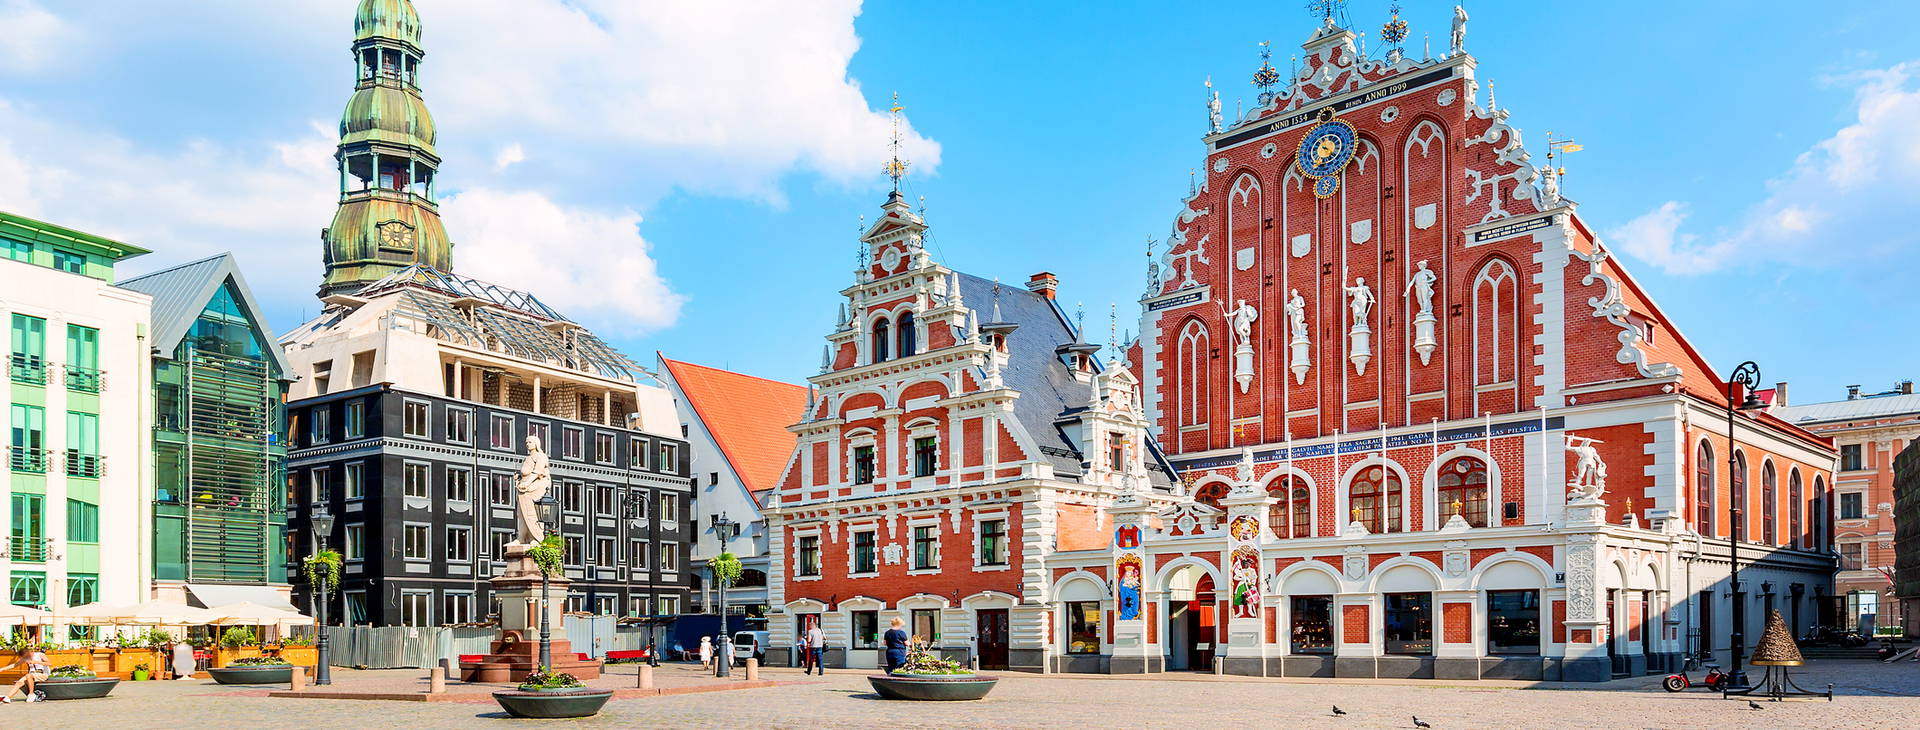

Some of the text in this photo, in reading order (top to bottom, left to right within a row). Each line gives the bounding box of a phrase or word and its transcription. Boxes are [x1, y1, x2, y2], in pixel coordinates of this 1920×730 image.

[1270, 120, 1289, 132] ANNO
[1365, 89, 1387, 102] ANNO
[1389, 82, 1407, 95] 1999
